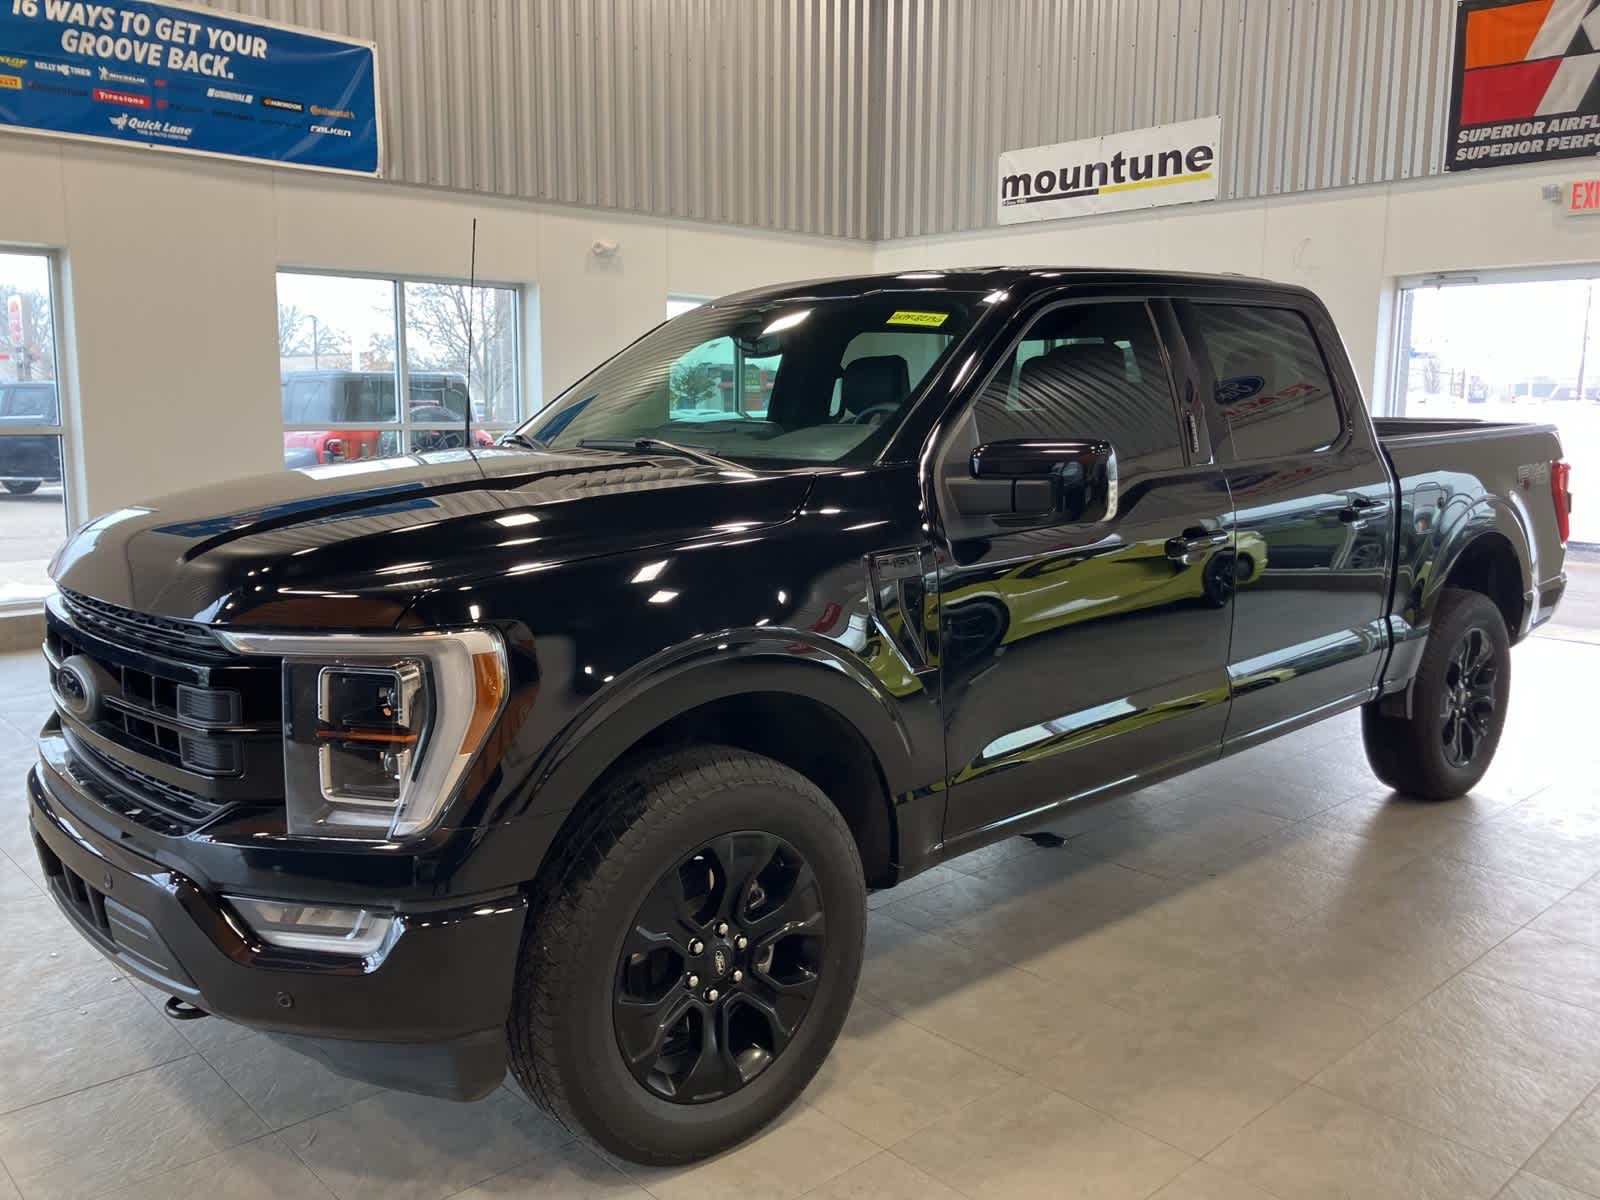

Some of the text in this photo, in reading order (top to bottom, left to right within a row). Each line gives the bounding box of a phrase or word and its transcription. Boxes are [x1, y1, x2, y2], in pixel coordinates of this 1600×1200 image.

[12, 0, 268, 59] 16 WAYS TO GET YOUR
[61, 28, 235, 80] GROOVE BACK.
[128, 117, 193, 136] Quick Lane
[1457, 114, 1600, 144] SUPERIOR AIRFL
[1455, 139, 1544, 161] SUPERIOR
[1002, 145, 1214, 199] mountune
